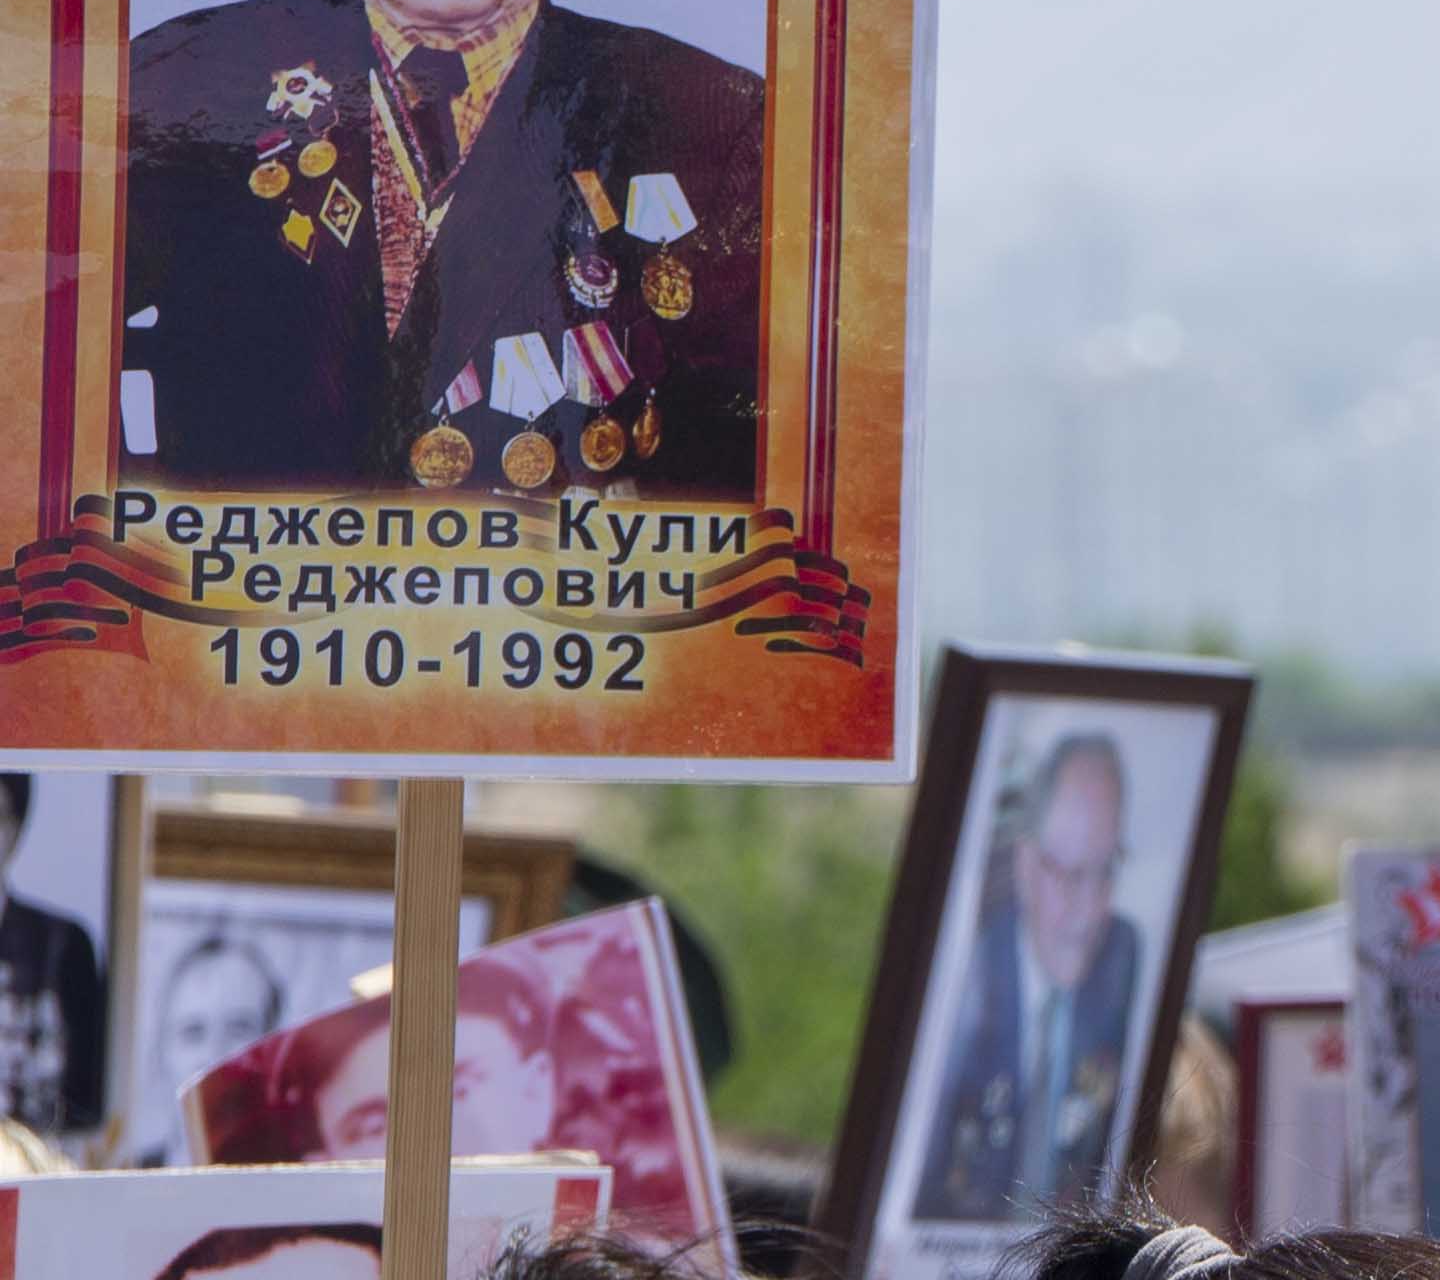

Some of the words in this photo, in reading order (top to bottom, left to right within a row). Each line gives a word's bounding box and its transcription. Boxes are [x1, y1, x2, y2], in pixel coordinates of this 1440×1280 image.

[112, 491, 519, 554] Реджепов
[557, 498, 748, 564] Кули
[191, 550, 696, 612] Реджепович
[209, 628, 647, 691] 1910-1992
